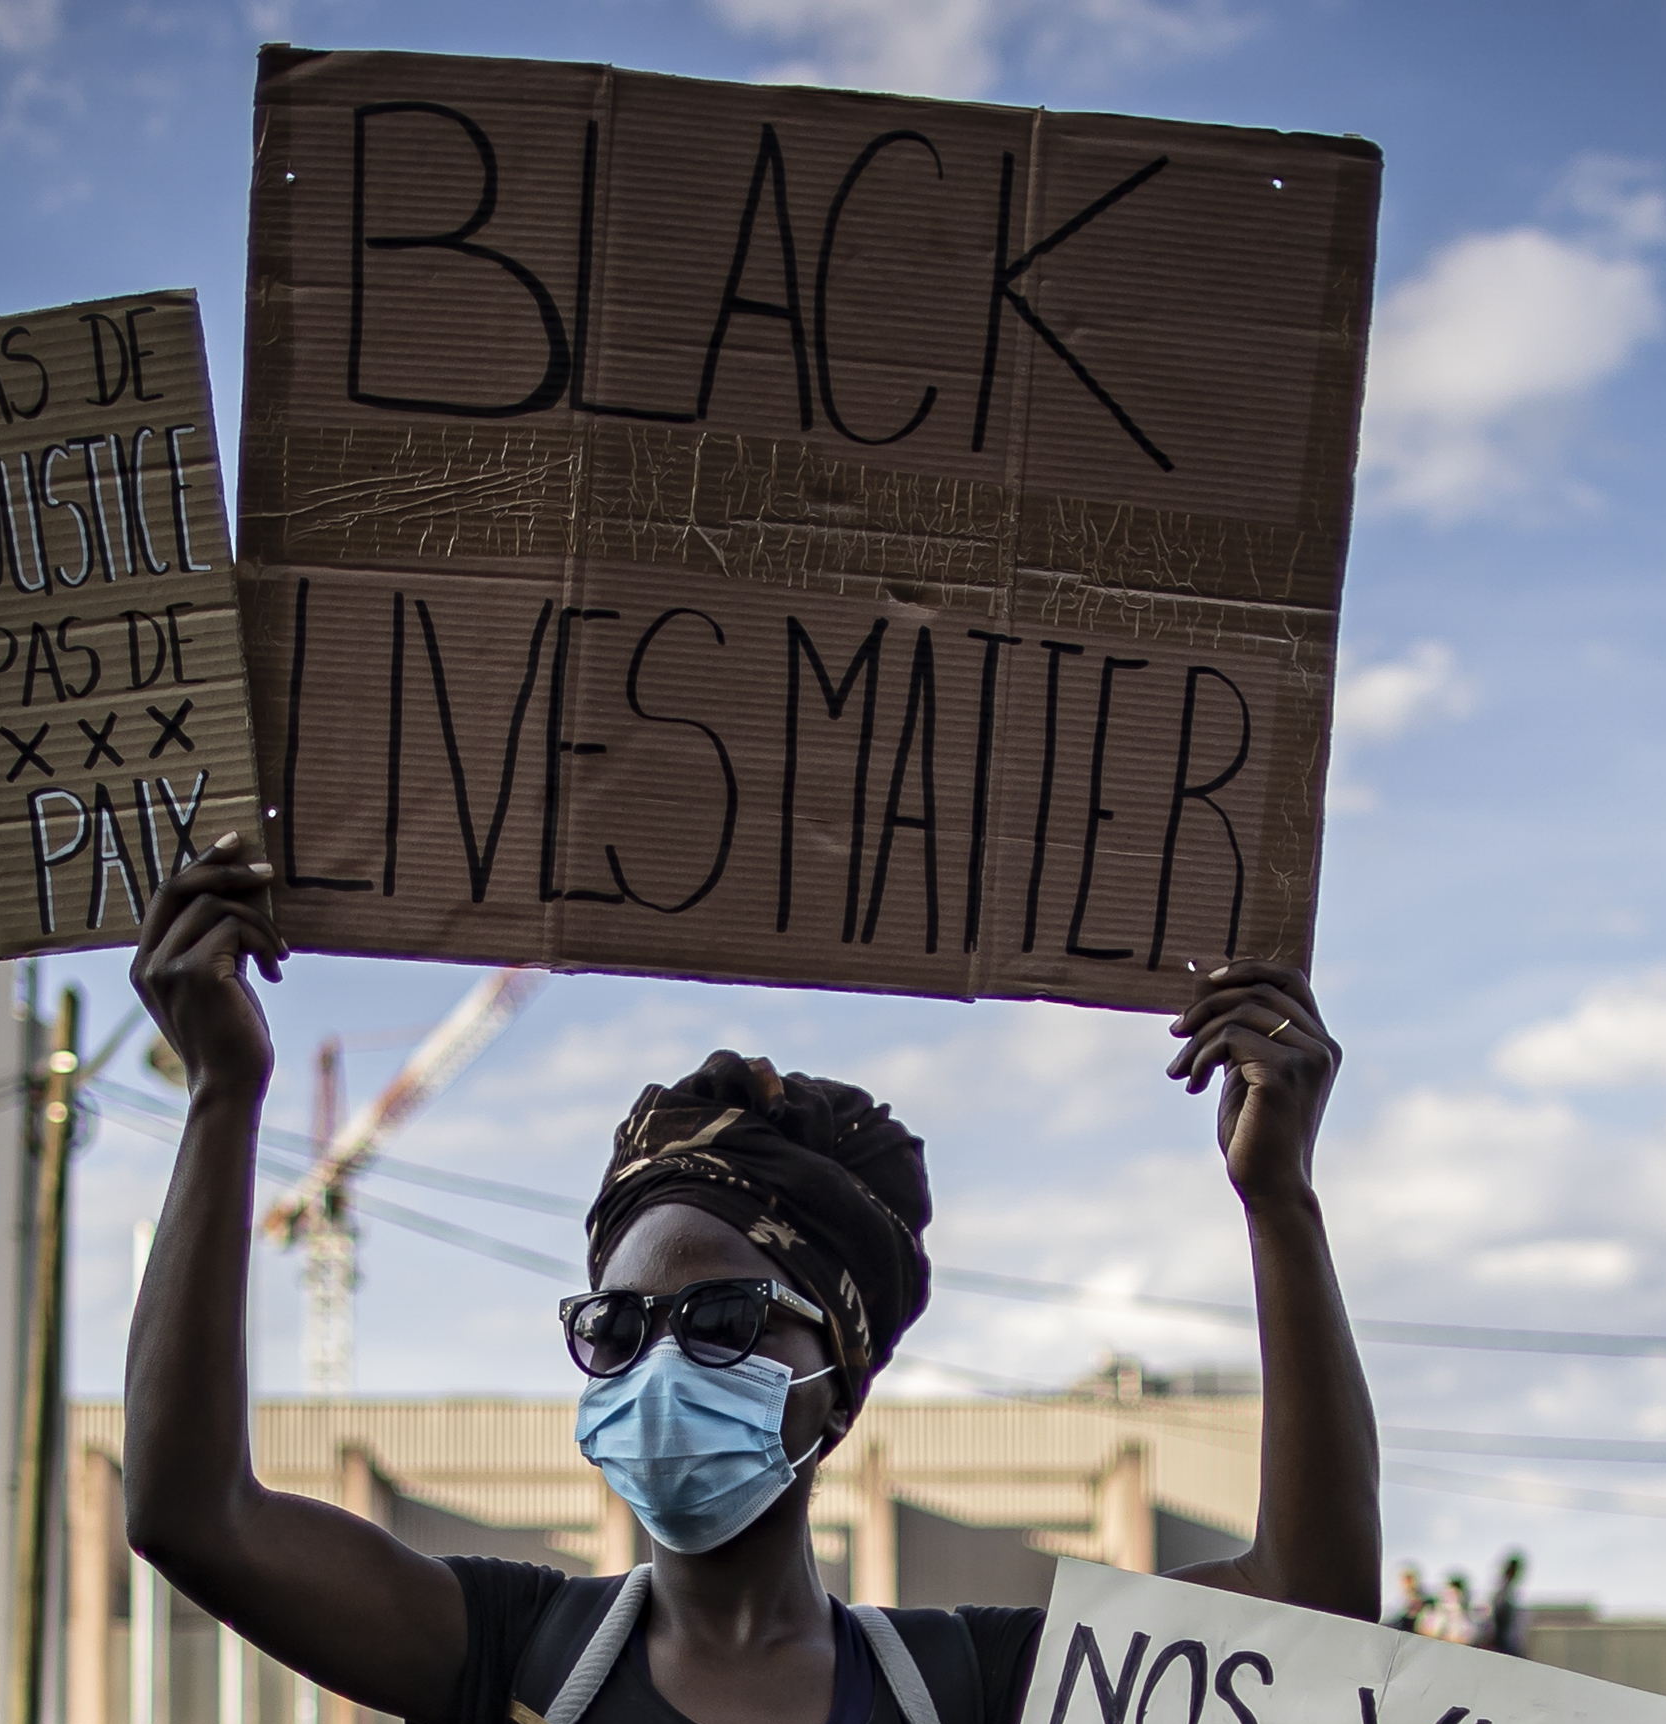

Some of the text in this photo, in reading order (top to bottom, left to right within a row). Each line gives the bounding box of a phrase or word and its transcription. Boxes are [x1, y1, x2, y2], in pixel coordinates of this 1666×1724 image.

[79, 306, 164, 406] DE
[348, 100, 1175, 472] BLACK
[119, 601, 207, 692] DE
[27, 768, 209, 935] PAIX
[283, 578, 1254, 972] LIVES MATTER
